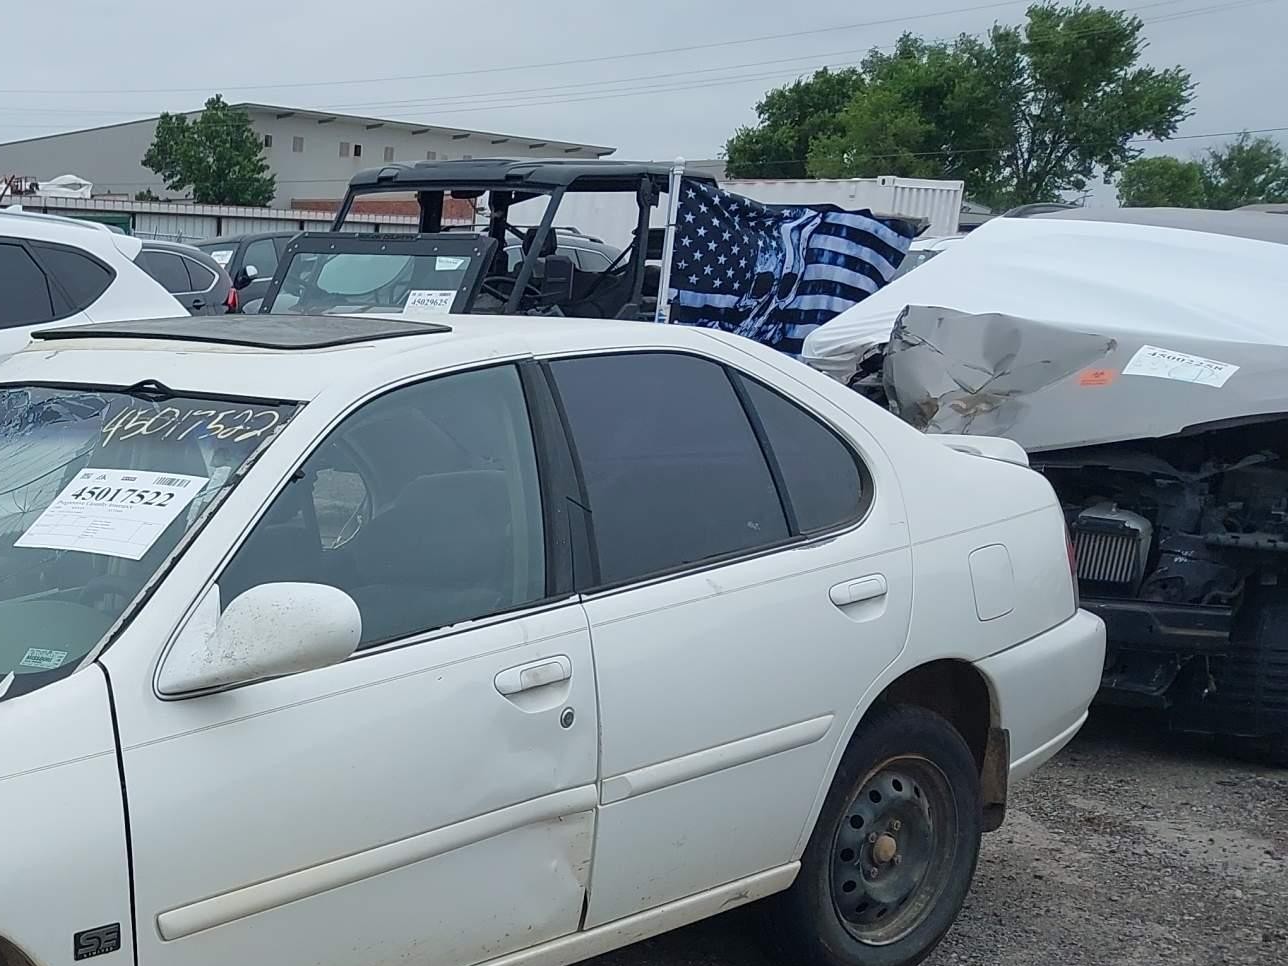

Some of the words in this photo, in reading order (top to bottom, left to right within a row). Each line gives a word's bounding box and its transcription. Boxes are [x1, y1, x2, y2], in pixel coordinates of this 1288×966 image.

[103, 406, 279, 447] 45017522
[72, 486, 175, 507] 45017522
[79, 925, 118, 955] SE
